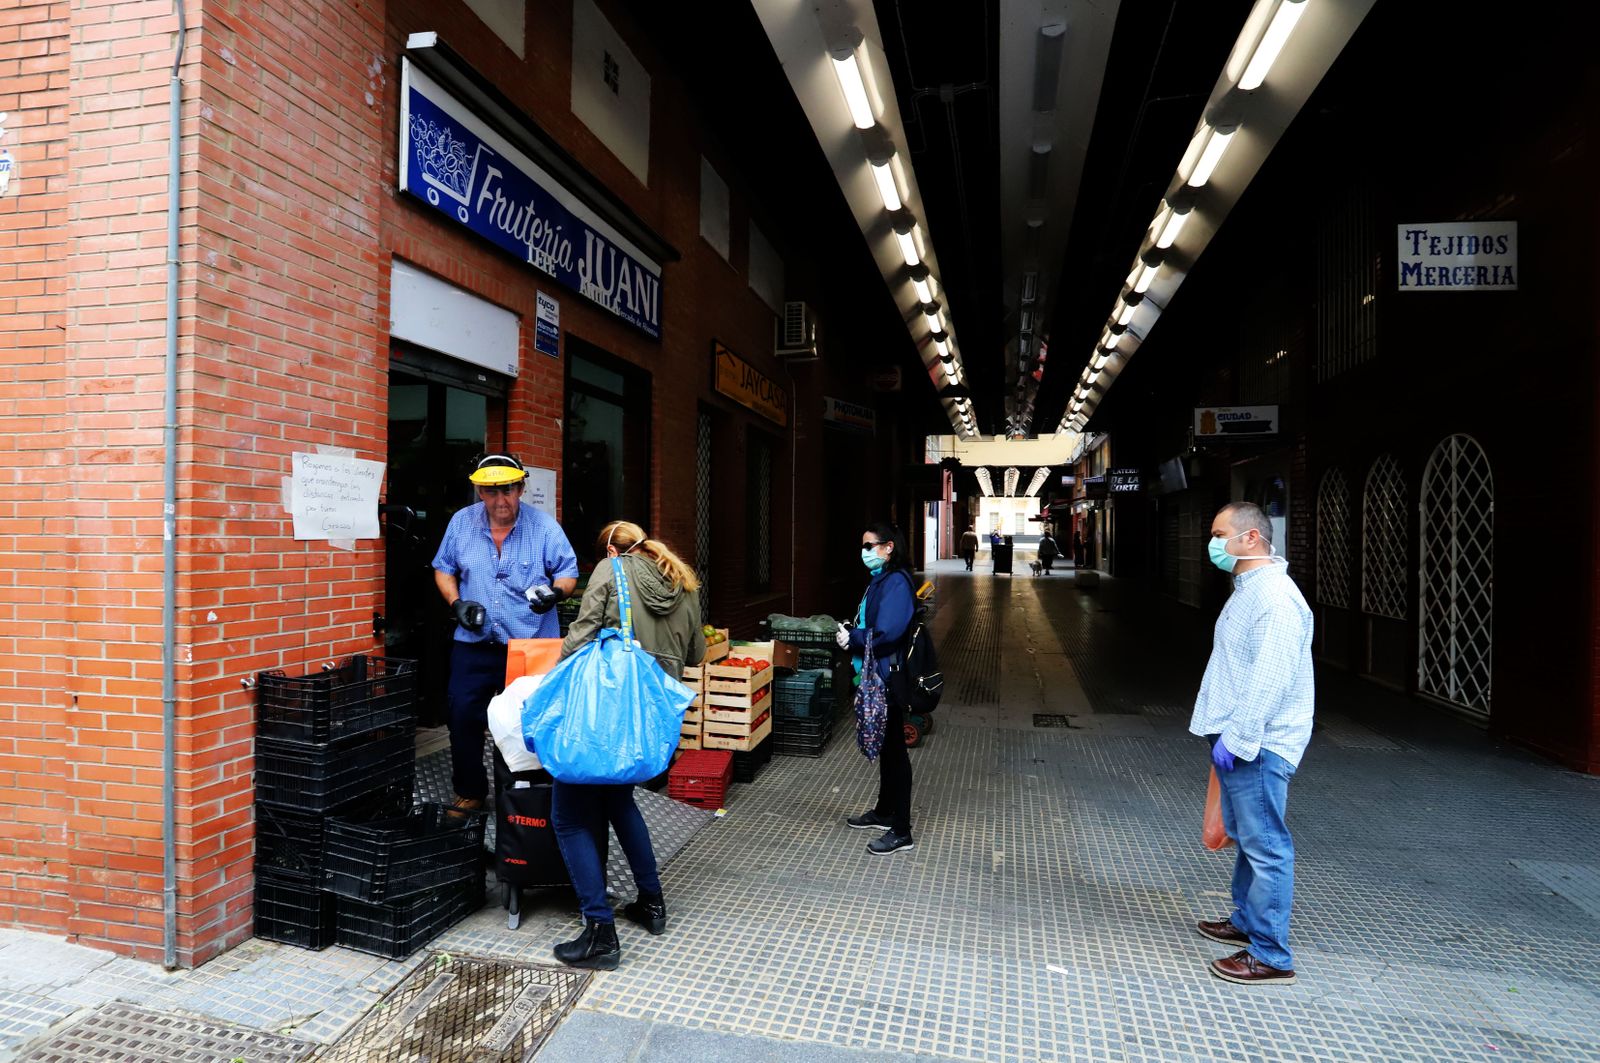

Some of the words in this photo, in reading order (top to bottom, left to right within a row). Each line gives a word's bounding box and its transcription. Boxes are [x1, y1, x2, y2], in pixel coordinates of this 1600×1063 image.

[1405, 229, 1509, 256] TEJIDOS
[577, 228, 660, 327] JUANI
[1400, 260, 1516, 287] MERCERIA
[538, 296, 555, 312] tyco
[740, 362, 787, 411] JAYCASA
[515, 815, 546, 828] TERMO
